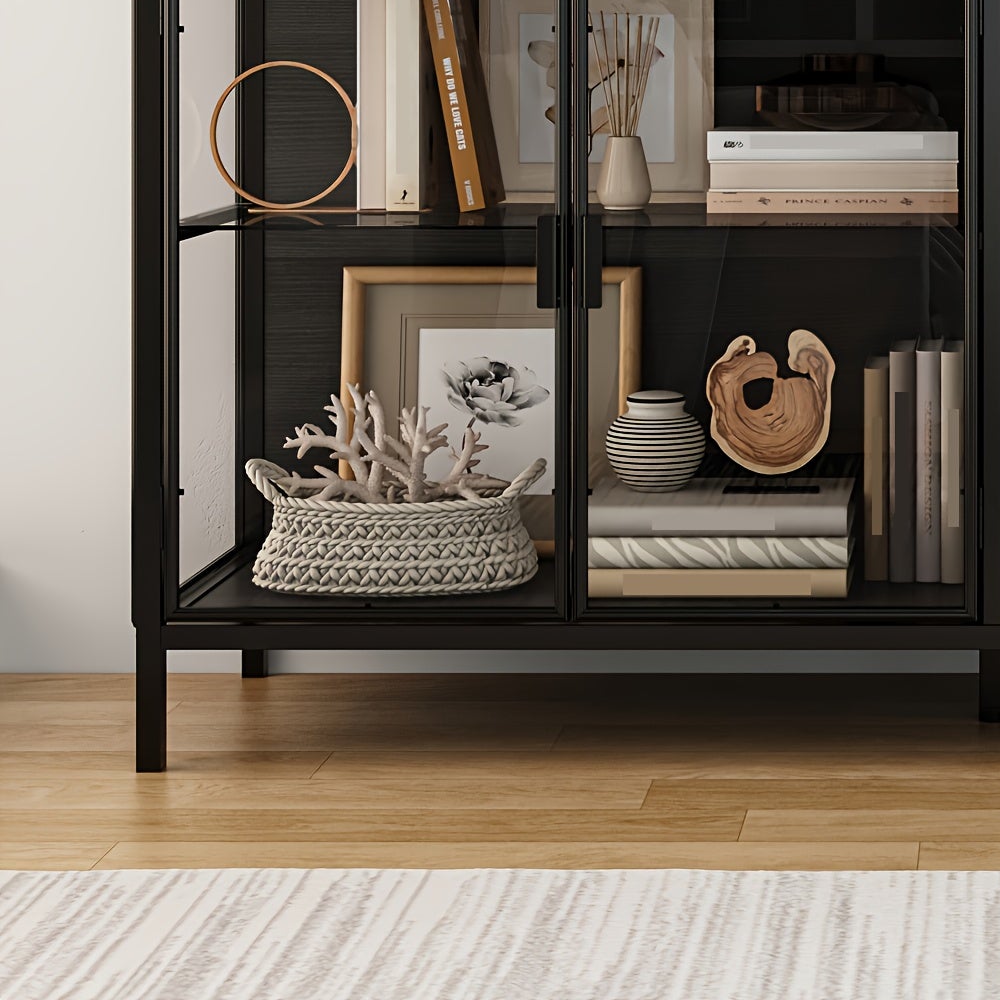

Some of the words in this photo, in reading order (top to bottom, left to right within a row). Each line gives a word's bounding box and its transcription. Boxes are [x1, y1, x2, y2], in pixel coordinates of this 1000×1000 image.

[443, 57, 453, 76] WHY
[446, 78, 455, 90] DO
[449, 91, 458, 105] WE
[452, 107, 462, 127] LOVE
[456, 129, 466, 150] CATS
